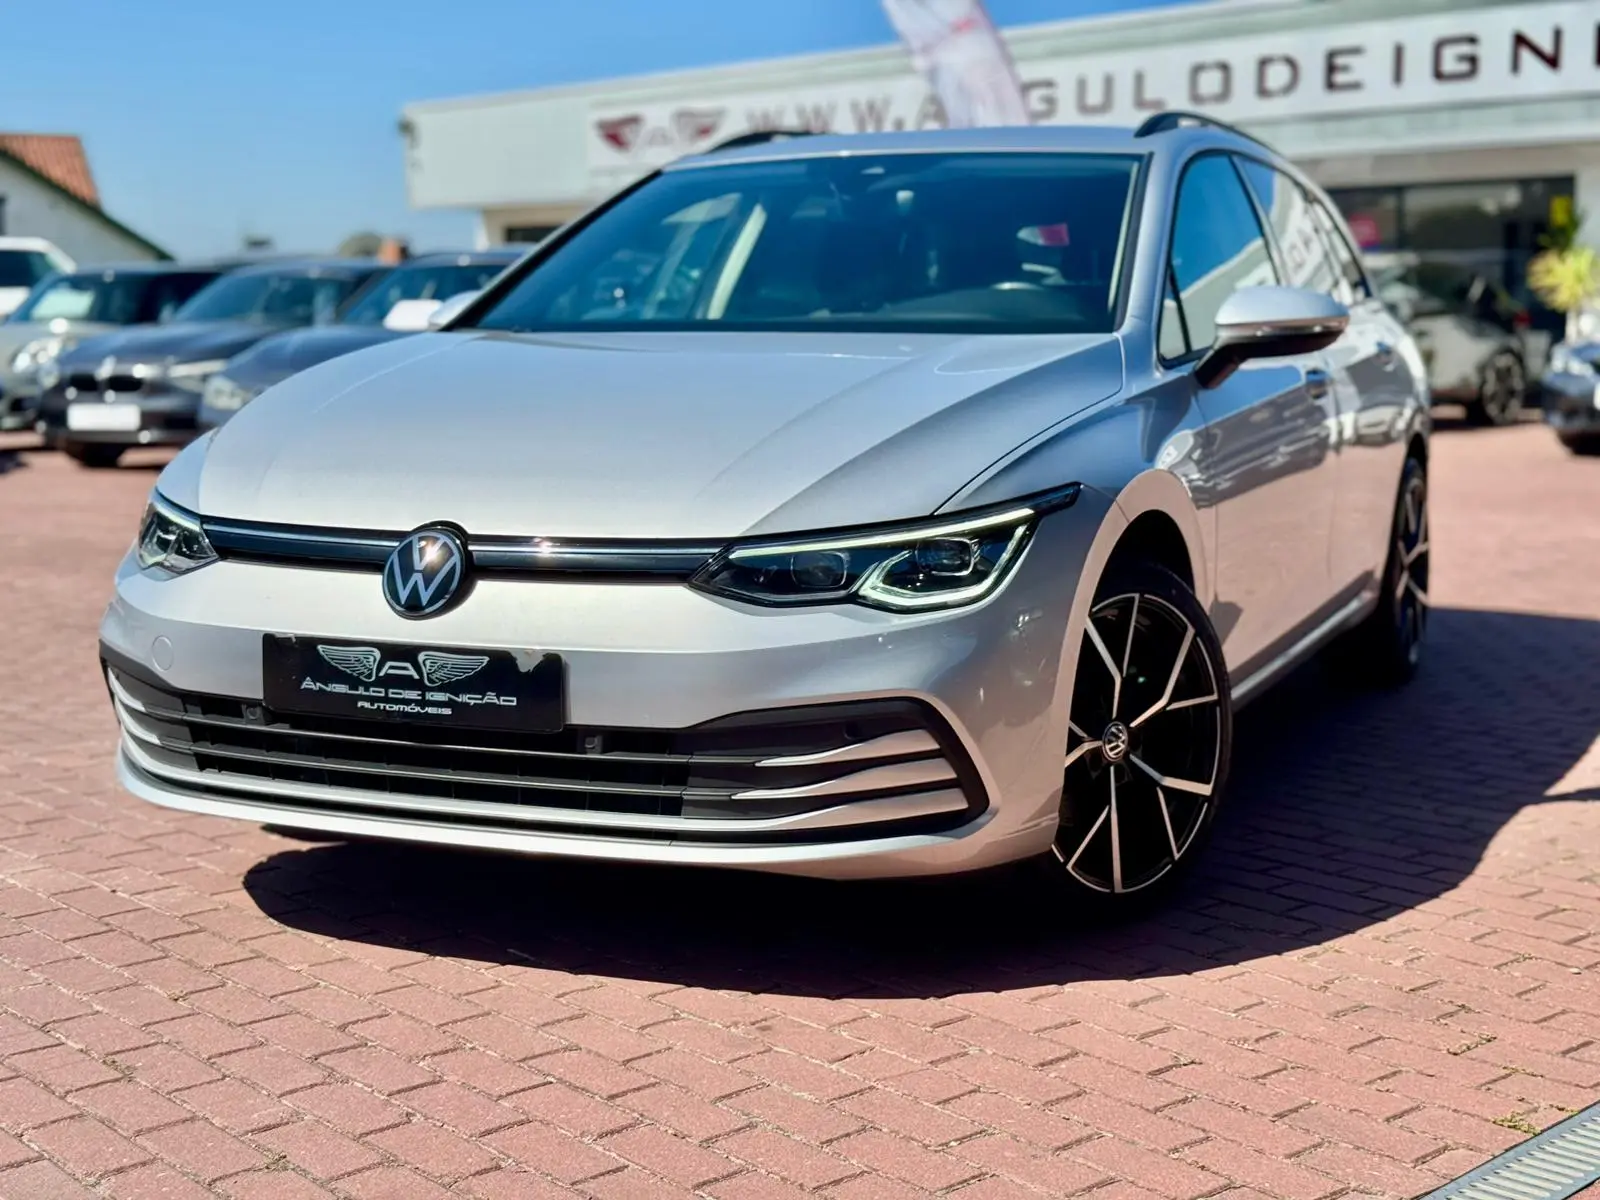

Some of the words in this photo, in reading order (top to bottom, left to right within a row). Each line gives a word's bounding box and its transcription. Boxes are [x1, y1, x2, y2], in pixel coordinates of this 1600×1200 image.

[378, 661, 420, 680] A
[300, 676, 386, 697] ÂNGULO
[388, 688, 422, 700] DE
[425, 691, 517, 706] IGNIÇÃO
[357, 700, 453, 715] AUTOMÓVEIS
